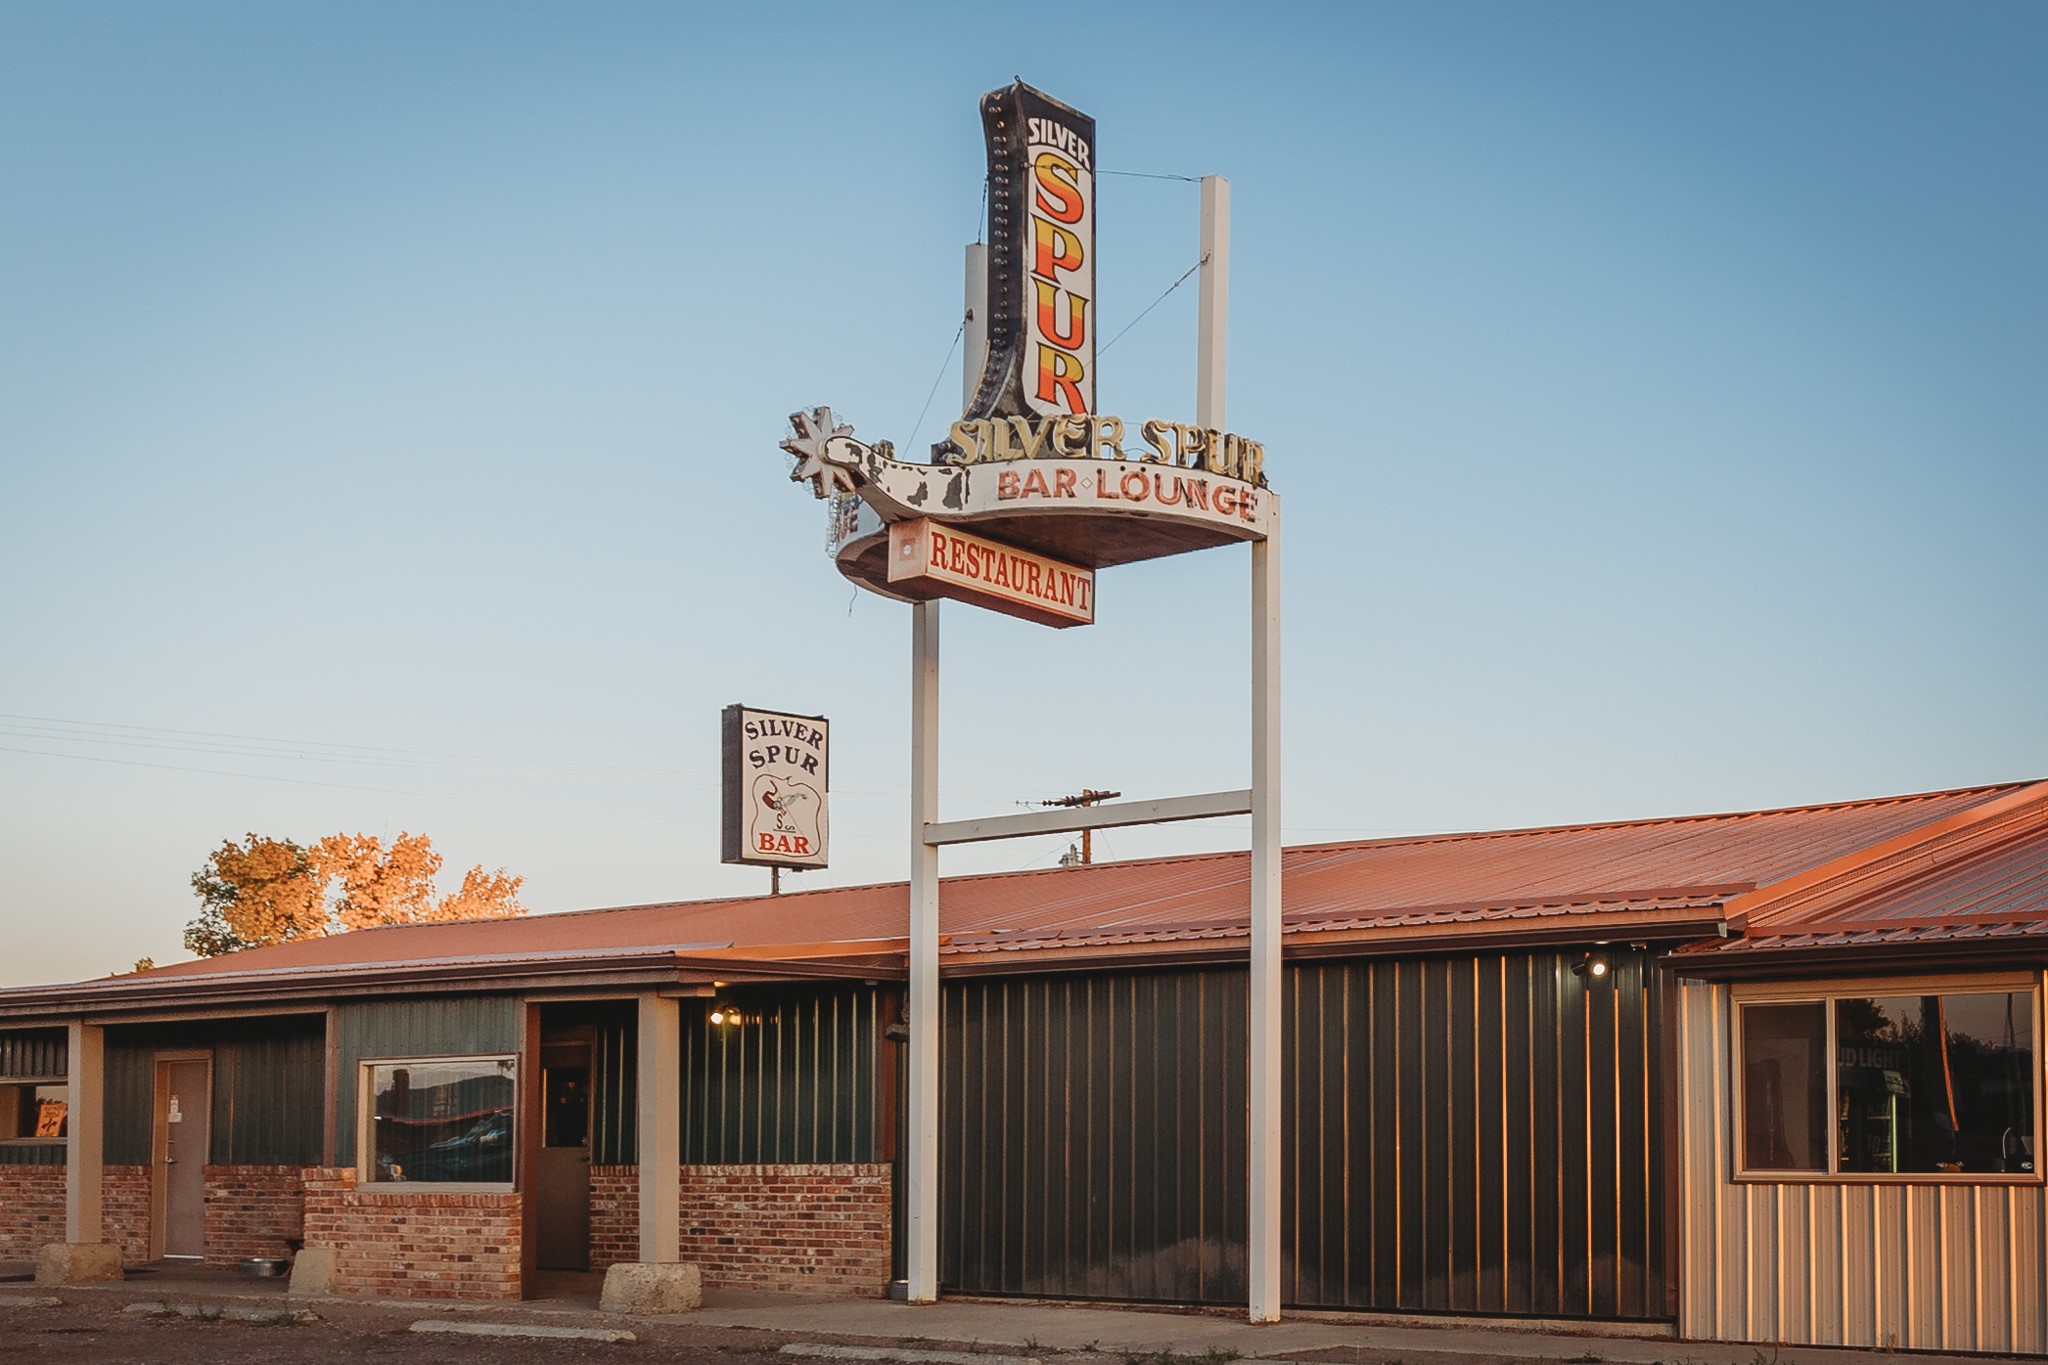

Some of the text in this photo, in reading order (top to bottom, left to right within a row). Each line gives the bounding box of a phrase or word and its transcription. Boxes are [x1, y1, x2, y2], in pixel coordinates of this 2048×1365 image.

[1028, 117, 1090, 168] SILVER
[1031, 151, 1090, 414] SPUR
[948, 414, 1266, 484] SILVER SPUR
[998, 466, 1258, 521] BAR LOUNGE
[931, 530, 1091, 611] RESTAURANT
[745, 719, 823, 750] SILVER
[749, 745, 819, 776] SPUR
[758, 832, 810, 854] BAR
